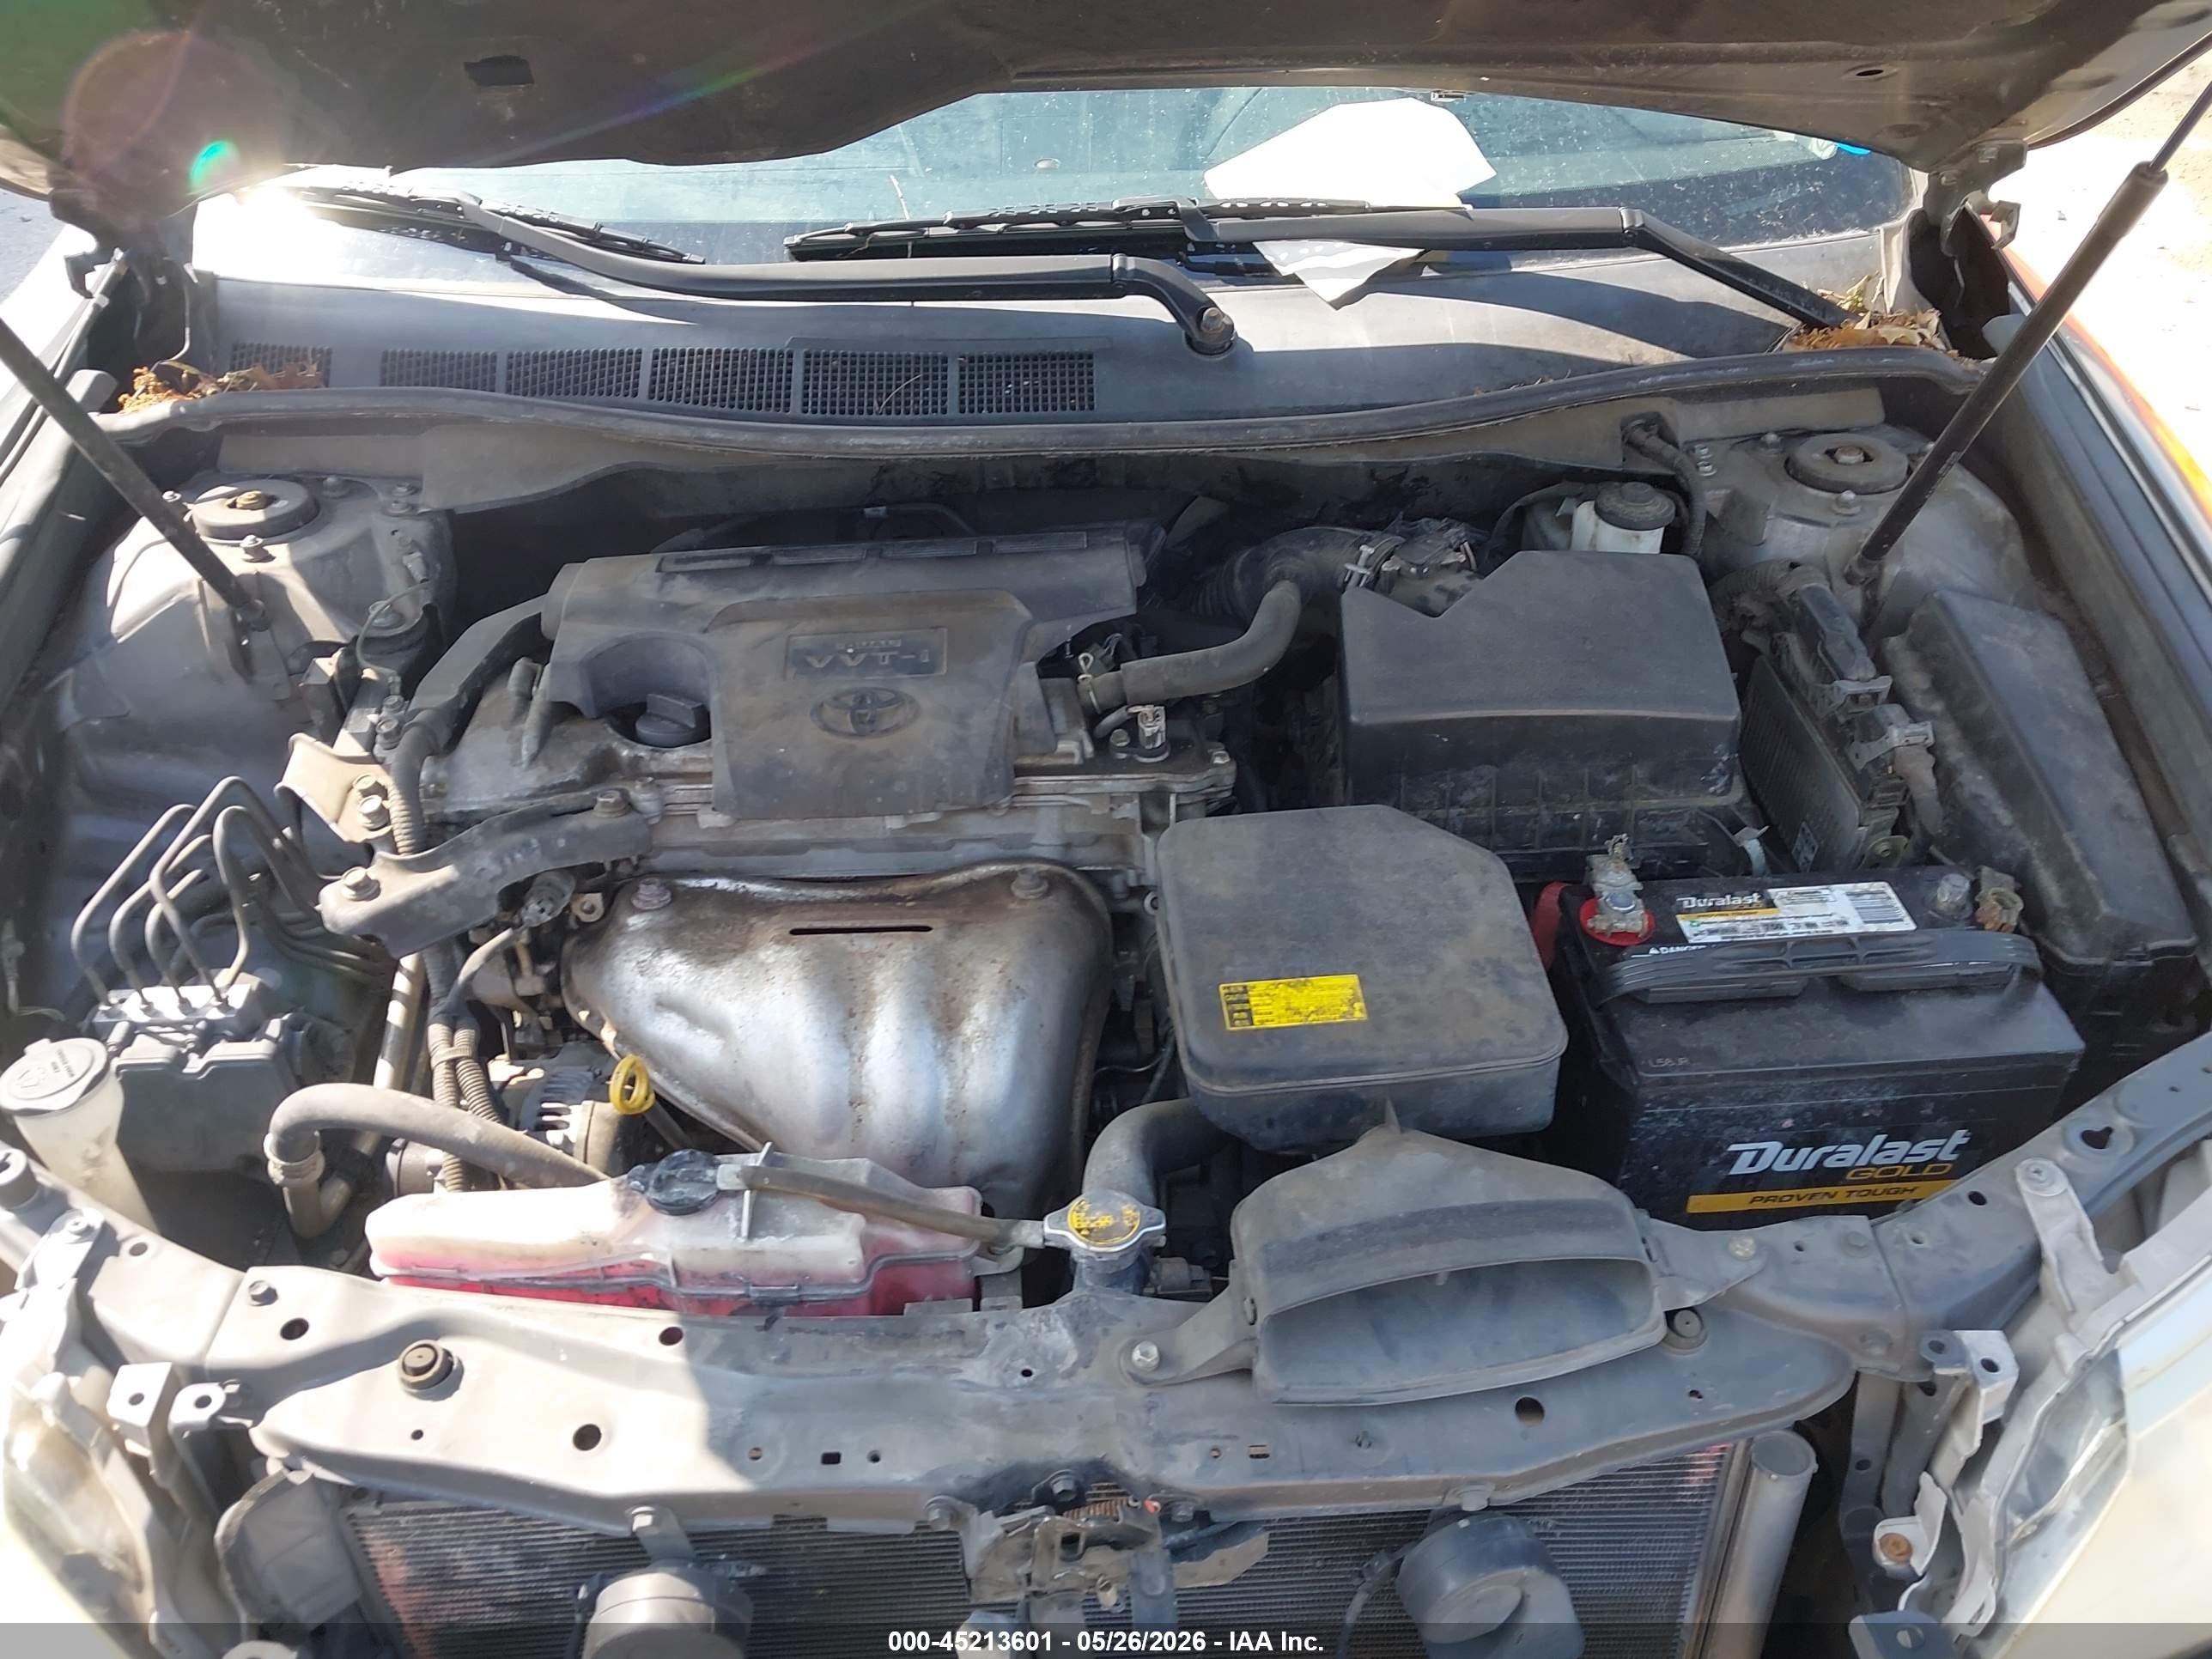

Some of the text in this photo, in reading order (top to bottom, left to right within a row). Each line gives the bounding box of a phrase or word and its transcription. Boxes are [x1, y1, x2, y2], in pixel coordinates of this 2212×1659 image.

[1676, 892, 1762, 908] Duralast
[1727, 1129, 1971, 1176] Duralast
[1846, 1163, 1953, 1181] GOLD
[1748, 1186, 1918, 1205] PROVEN TOUGH
